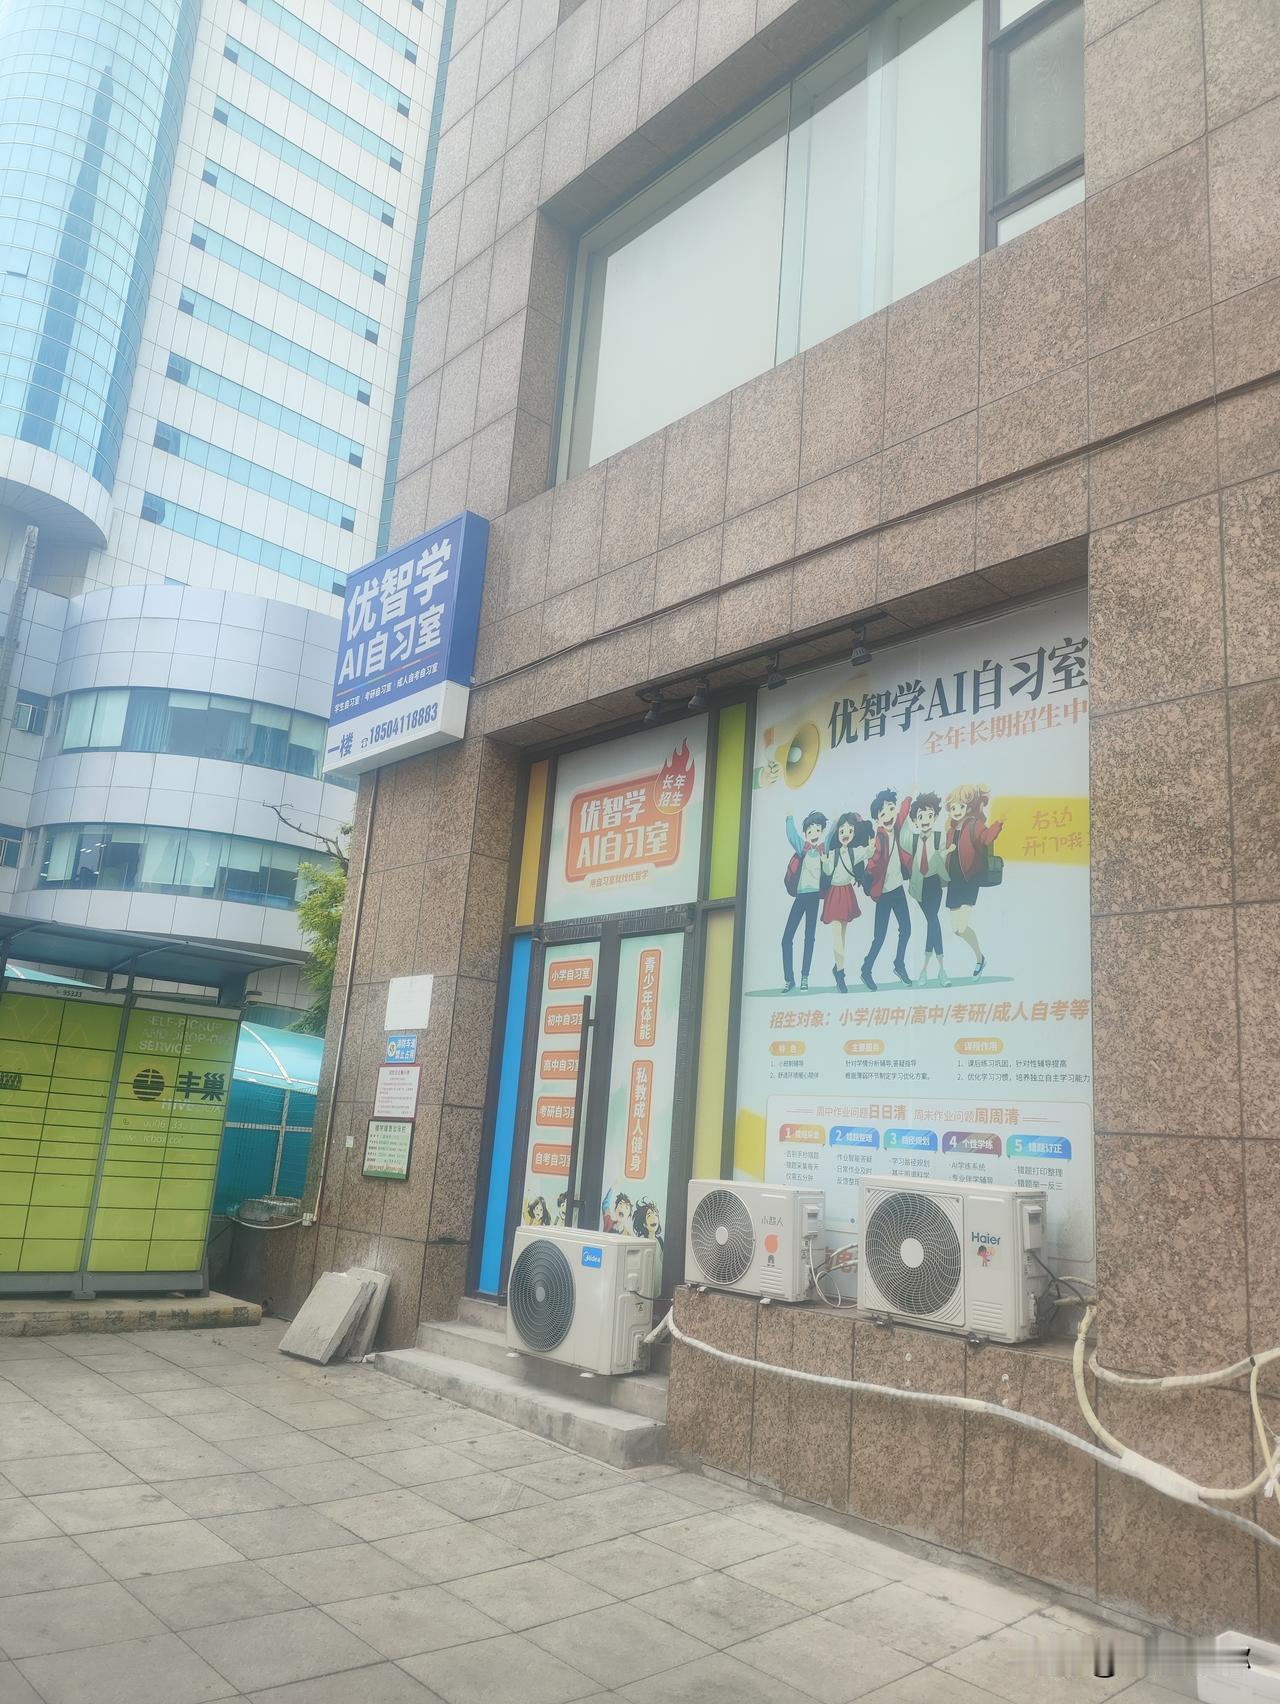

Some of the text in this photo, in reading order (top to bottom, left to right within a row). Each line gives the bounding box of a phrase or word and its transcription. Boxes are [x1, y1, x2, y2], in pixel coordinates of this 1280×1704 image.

[347, 538, 452, 641] 优智学
[338, 603, 445, 685] AI自习室
[334, 662, 438, 713] 学生自习室 考研自习室 成人自考自习室
[827, 637, 1089, 750] 优智学AI自习室
[328, 702, 439, 758] 一楼 18504118883
[923, 697, 1089, 755] 全年长期招生中
[662, 774, 686, 790] 长年
[580, 788, 646, 833] 优智学
[658, 791, 683, 807] 招生
[1032, 806, 1072, 831] 右边
[576, 821, 669, 869] AI自习室
[551, 966, 591, 982] 小学自习室
[639, 956, 656, 1040] 青少年体能
[140, 1040, 192, 1054] SERVICE
[176, 1071, 225, 1101] 丰巢
[630, 1067, 648, 1173] 私教成人健身
[816, 1104, 1020, 1125] 周中作业问题日日清 周末作业问题周周清
[835, 1130, 842, 1141] 2
[890, 1133, 897, 1145] 3
[949, 1136, 957, 1148] 4
[1015, 1140, 1023, 1152] 5
[760, 1215, 784, 1228] 小超人
[971, 1231, 1001, 1247] Haier
[583, 1251, 601, 1264] Midea
